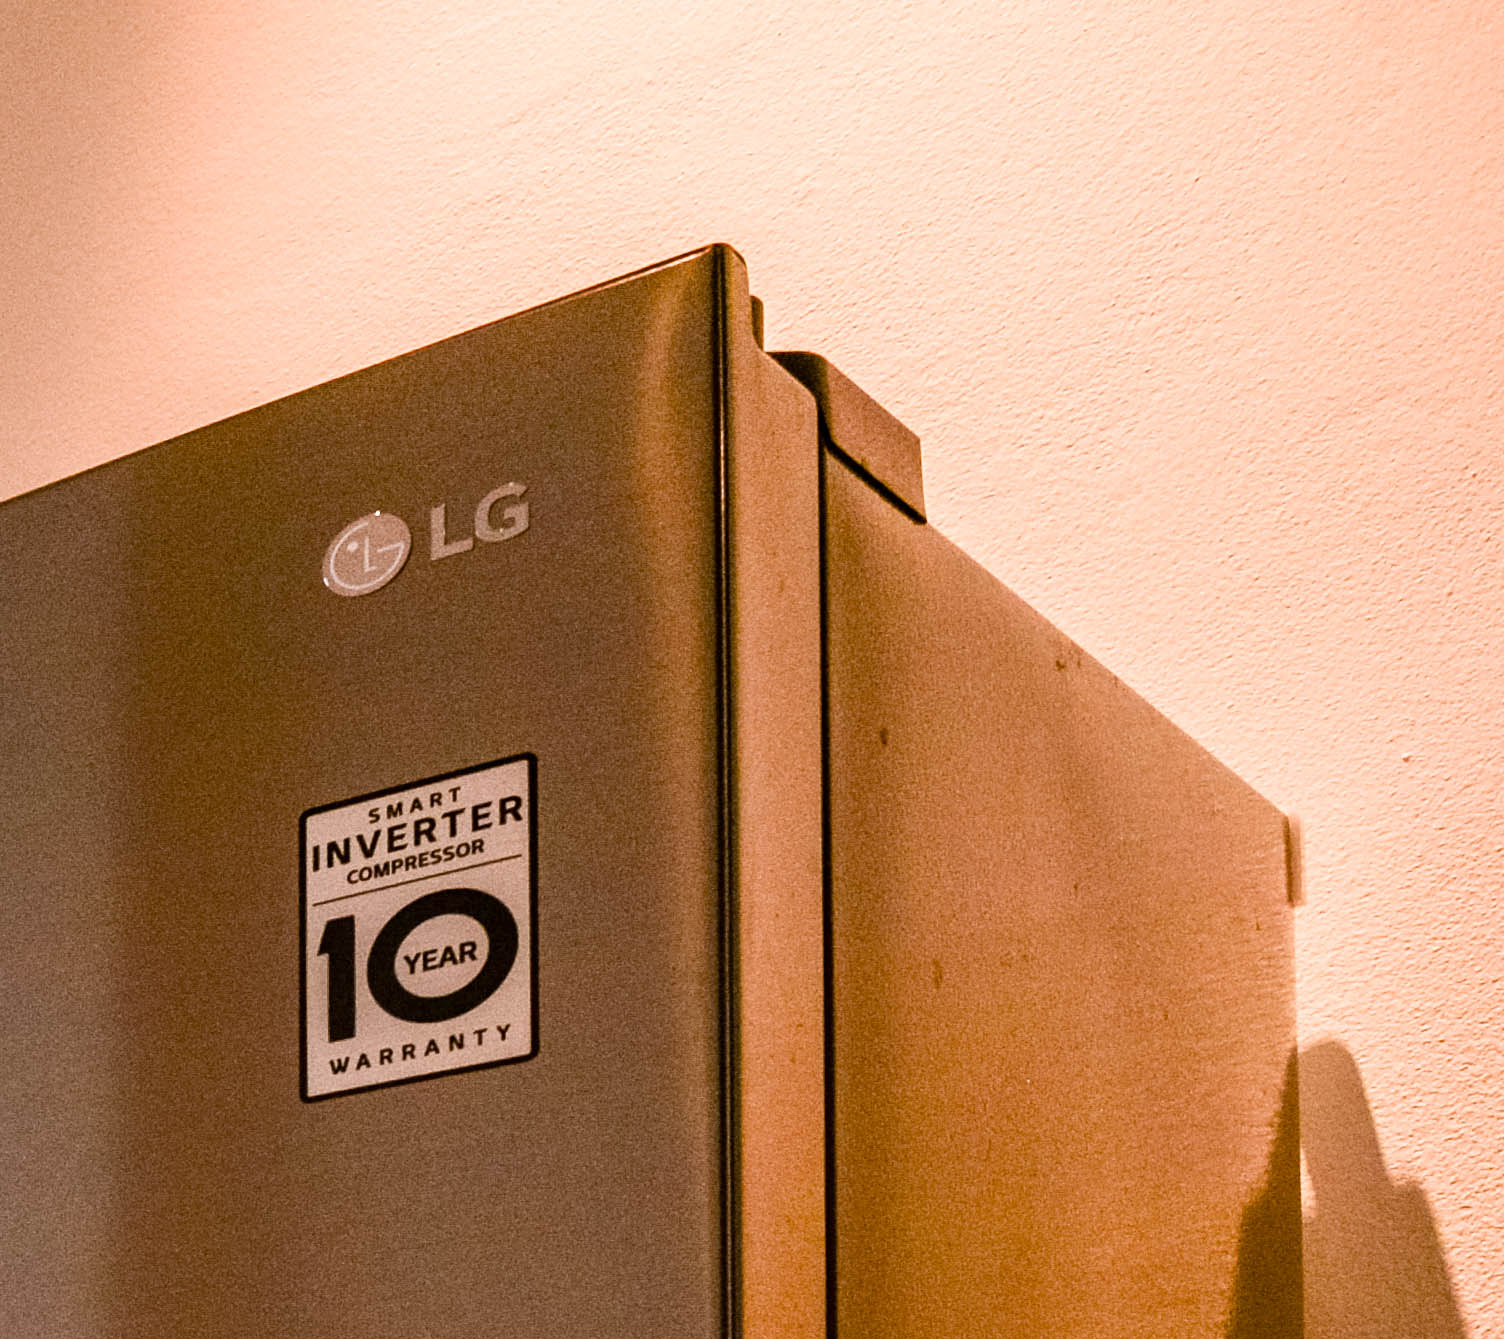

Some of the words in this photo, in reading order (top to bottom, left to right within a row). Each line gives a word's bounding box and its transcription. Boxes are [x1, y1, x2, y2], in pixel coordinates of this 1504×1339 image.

[430, 482, 530, 561] LG
[368, 786, 461, 824] SMART
[312, 795, 524, 873] INVERTER
[346, 838, 485, 884] COMPRESSOR
[317, 888, 519, 1044] 10
[403, 941, 478, 976] YEAR
[329, 1023, 511, 1075] WARRANTY
